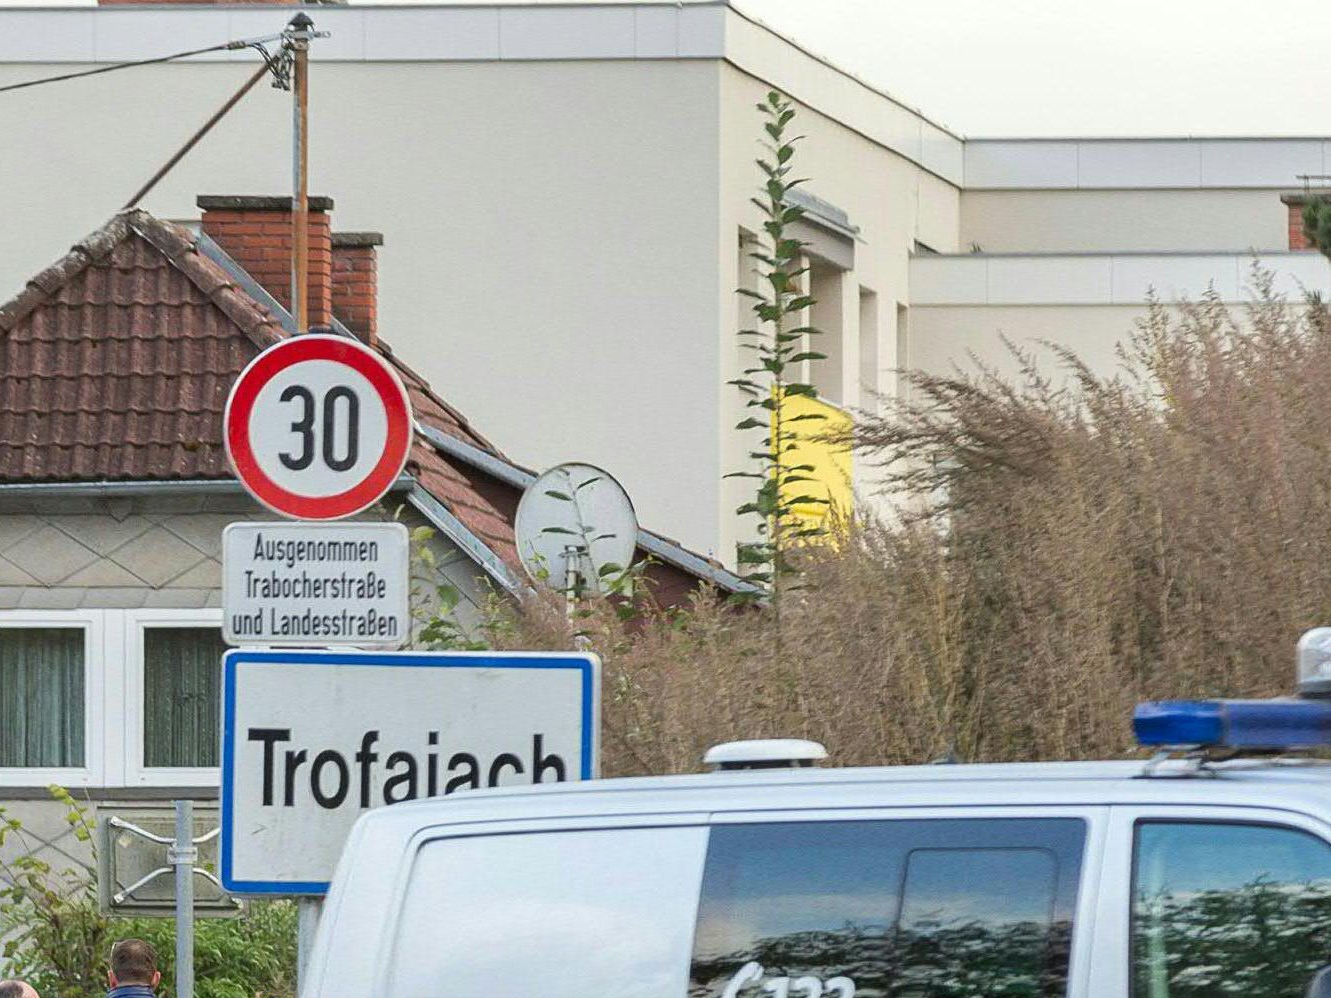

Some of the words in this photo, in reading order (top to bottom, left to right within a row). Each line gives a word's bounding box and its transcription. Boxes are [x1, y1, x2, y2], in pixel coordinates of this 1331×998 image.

[278, 385, 360, 472] 30
[253, 533, 379, 568] Ausgenommen
[245, 570, 387, 599] Trabocherstraße
[232, 608, 263, 635] und
[271, 608, 398, 637] Landesstraßen
[247, 727, 567, 810] Trofaiach
